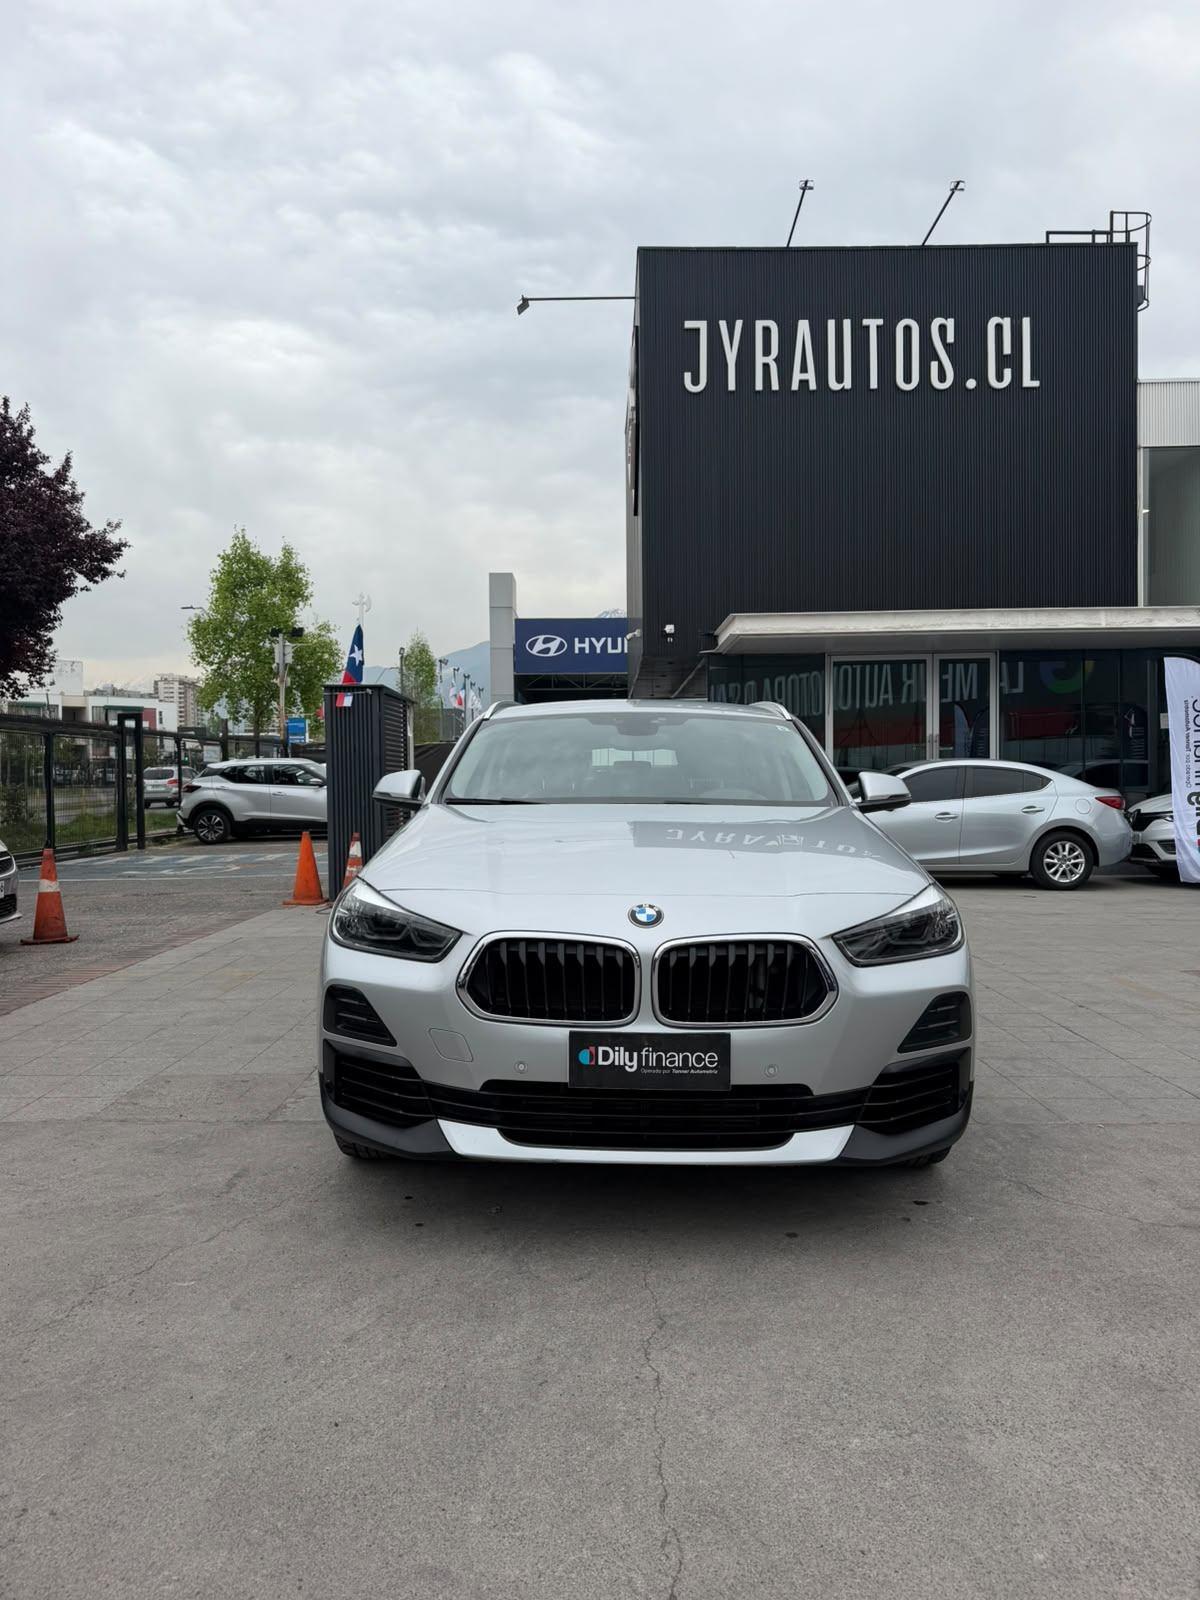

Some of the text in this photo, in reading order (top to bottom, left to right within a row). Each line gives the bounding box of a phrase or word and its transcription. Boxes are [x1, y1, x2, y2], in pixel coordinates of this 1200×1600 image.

[684, 316, 1041, 393] JYRAUTOS.CL
[574, 637, 628, 654] HYU
[598, 1046, 718, 1072] Dily finance
